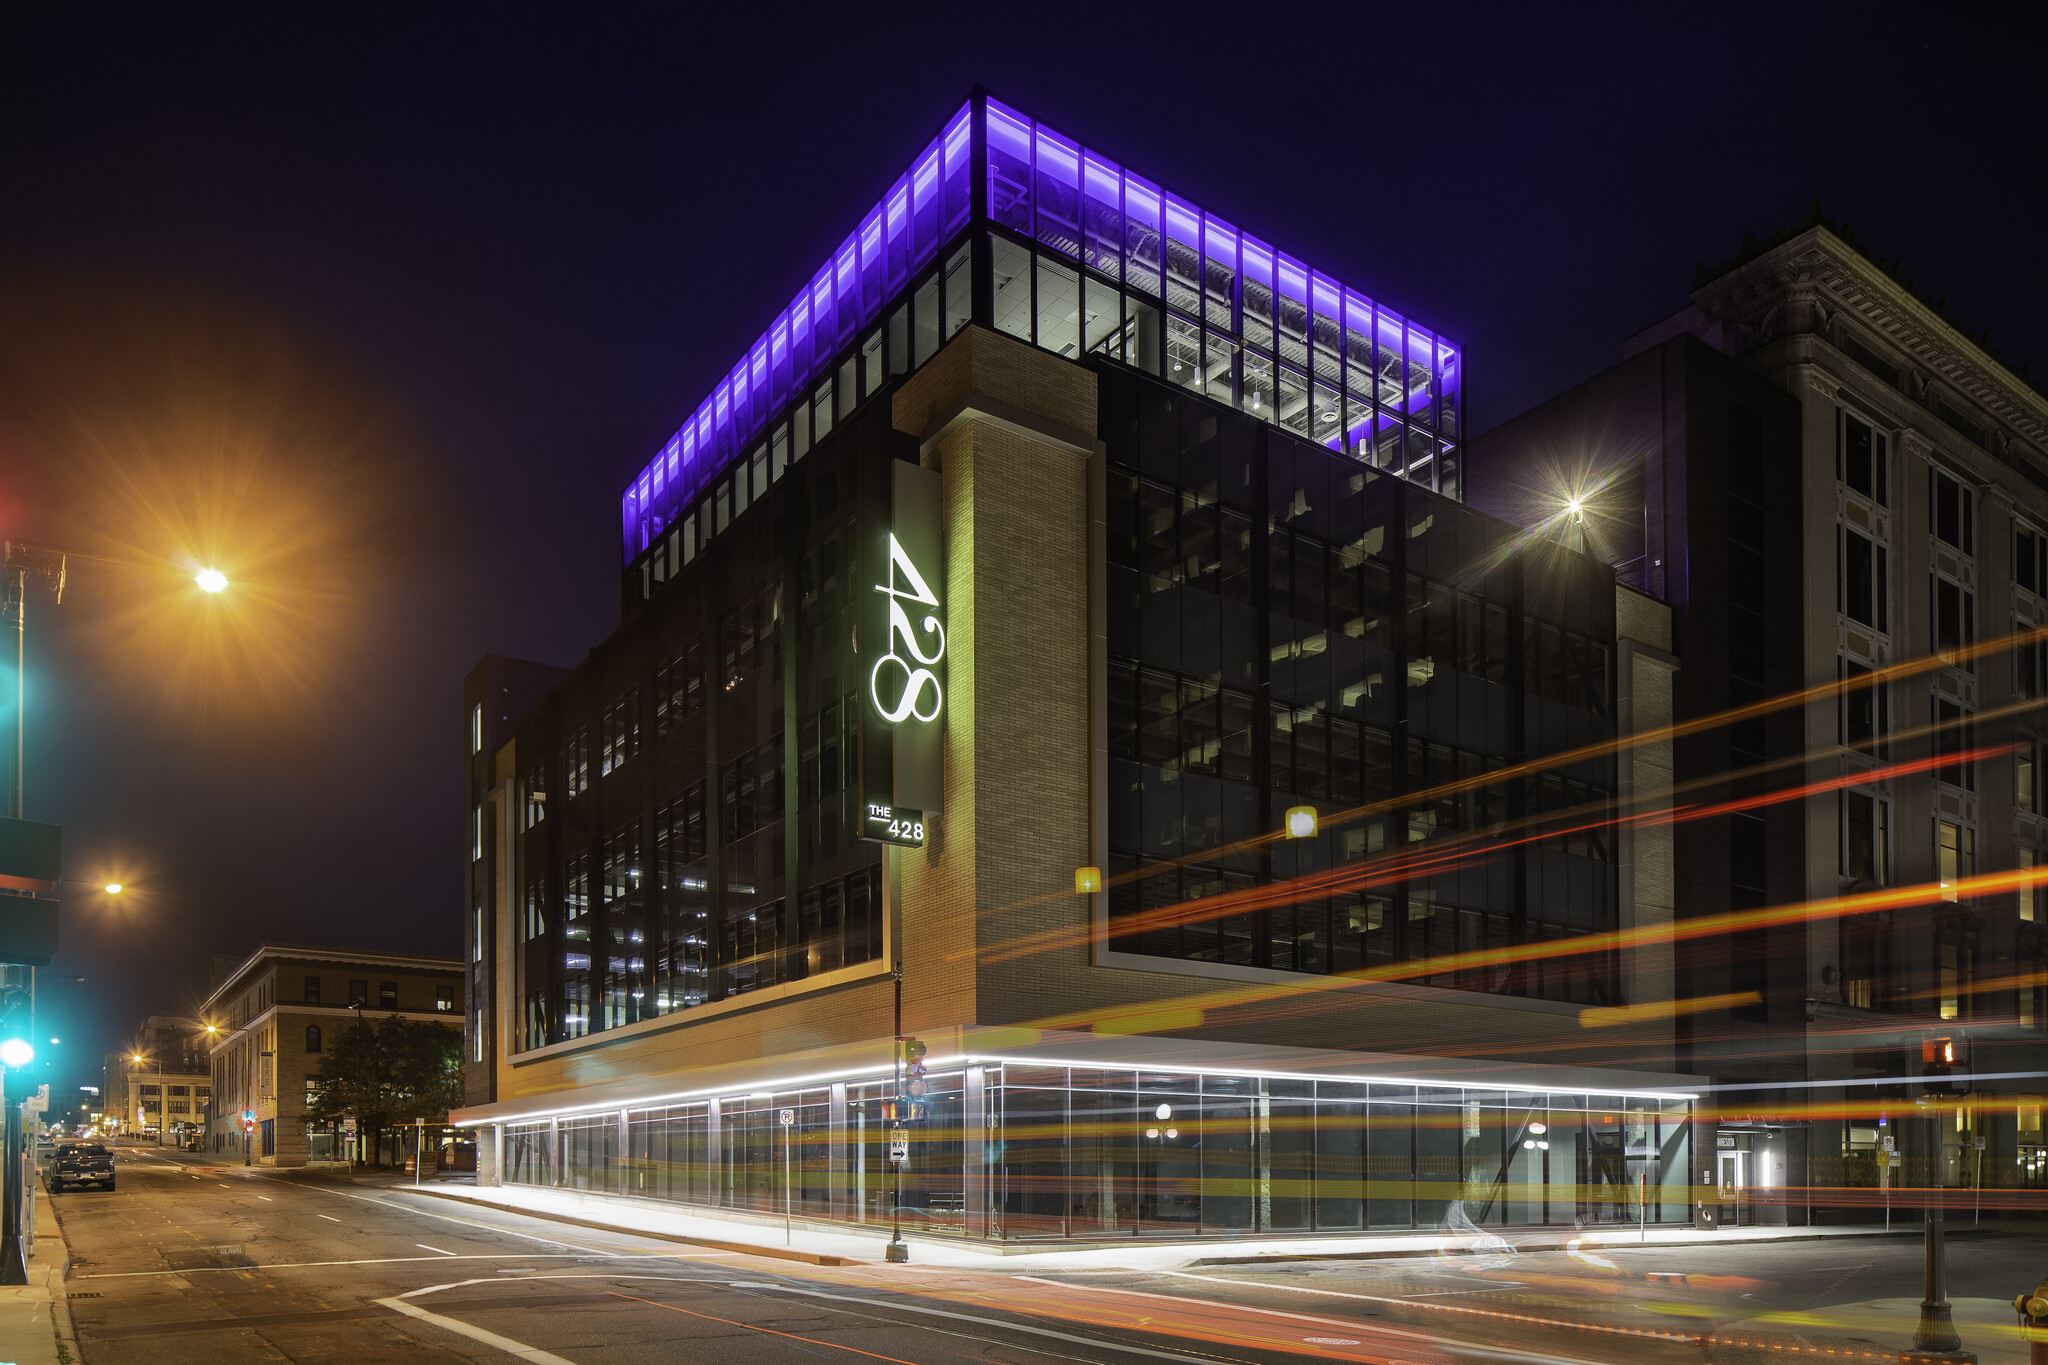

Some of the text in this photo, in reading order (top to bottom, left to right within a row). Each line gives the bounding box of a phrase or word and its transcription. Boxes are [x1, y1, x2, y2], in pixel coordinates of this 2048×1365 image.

[871, 532, 945, 722] 428
[869, 804, 891, 818] THE
[888, 819, 924, 840] 428
[892, 1132, 907, 1140] ONE
[892, 1141, 907, 1149] WAY
